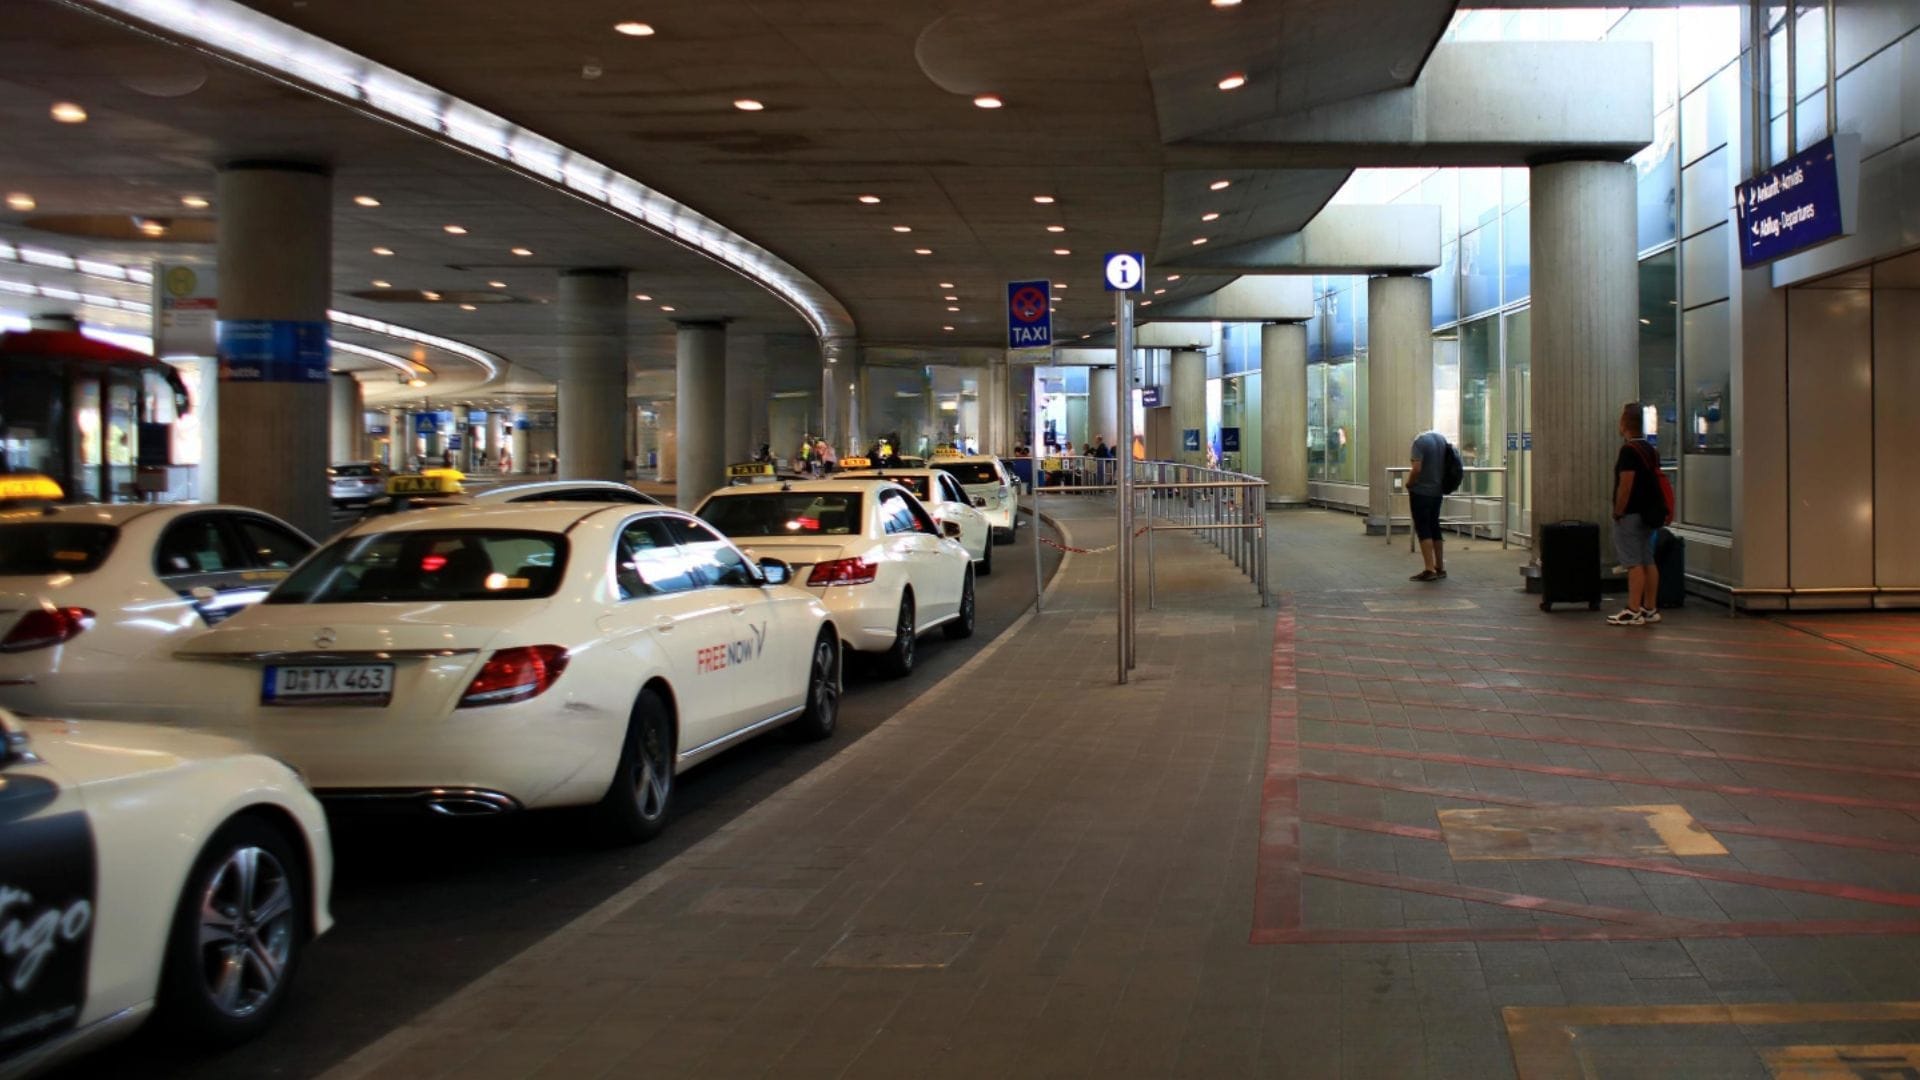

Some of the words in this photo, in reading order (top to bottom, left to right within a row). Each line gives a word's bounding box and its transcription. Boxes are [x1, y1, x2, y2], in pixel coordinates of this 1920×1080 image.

[1781, 203, 1815, 231] Departures
[1012, 326, 1048, 344] TAXI
[736, 466, 763, 475] TAXI
[397, 477, 441, 490] TAXI
[344, 667, 384, 689] 463
